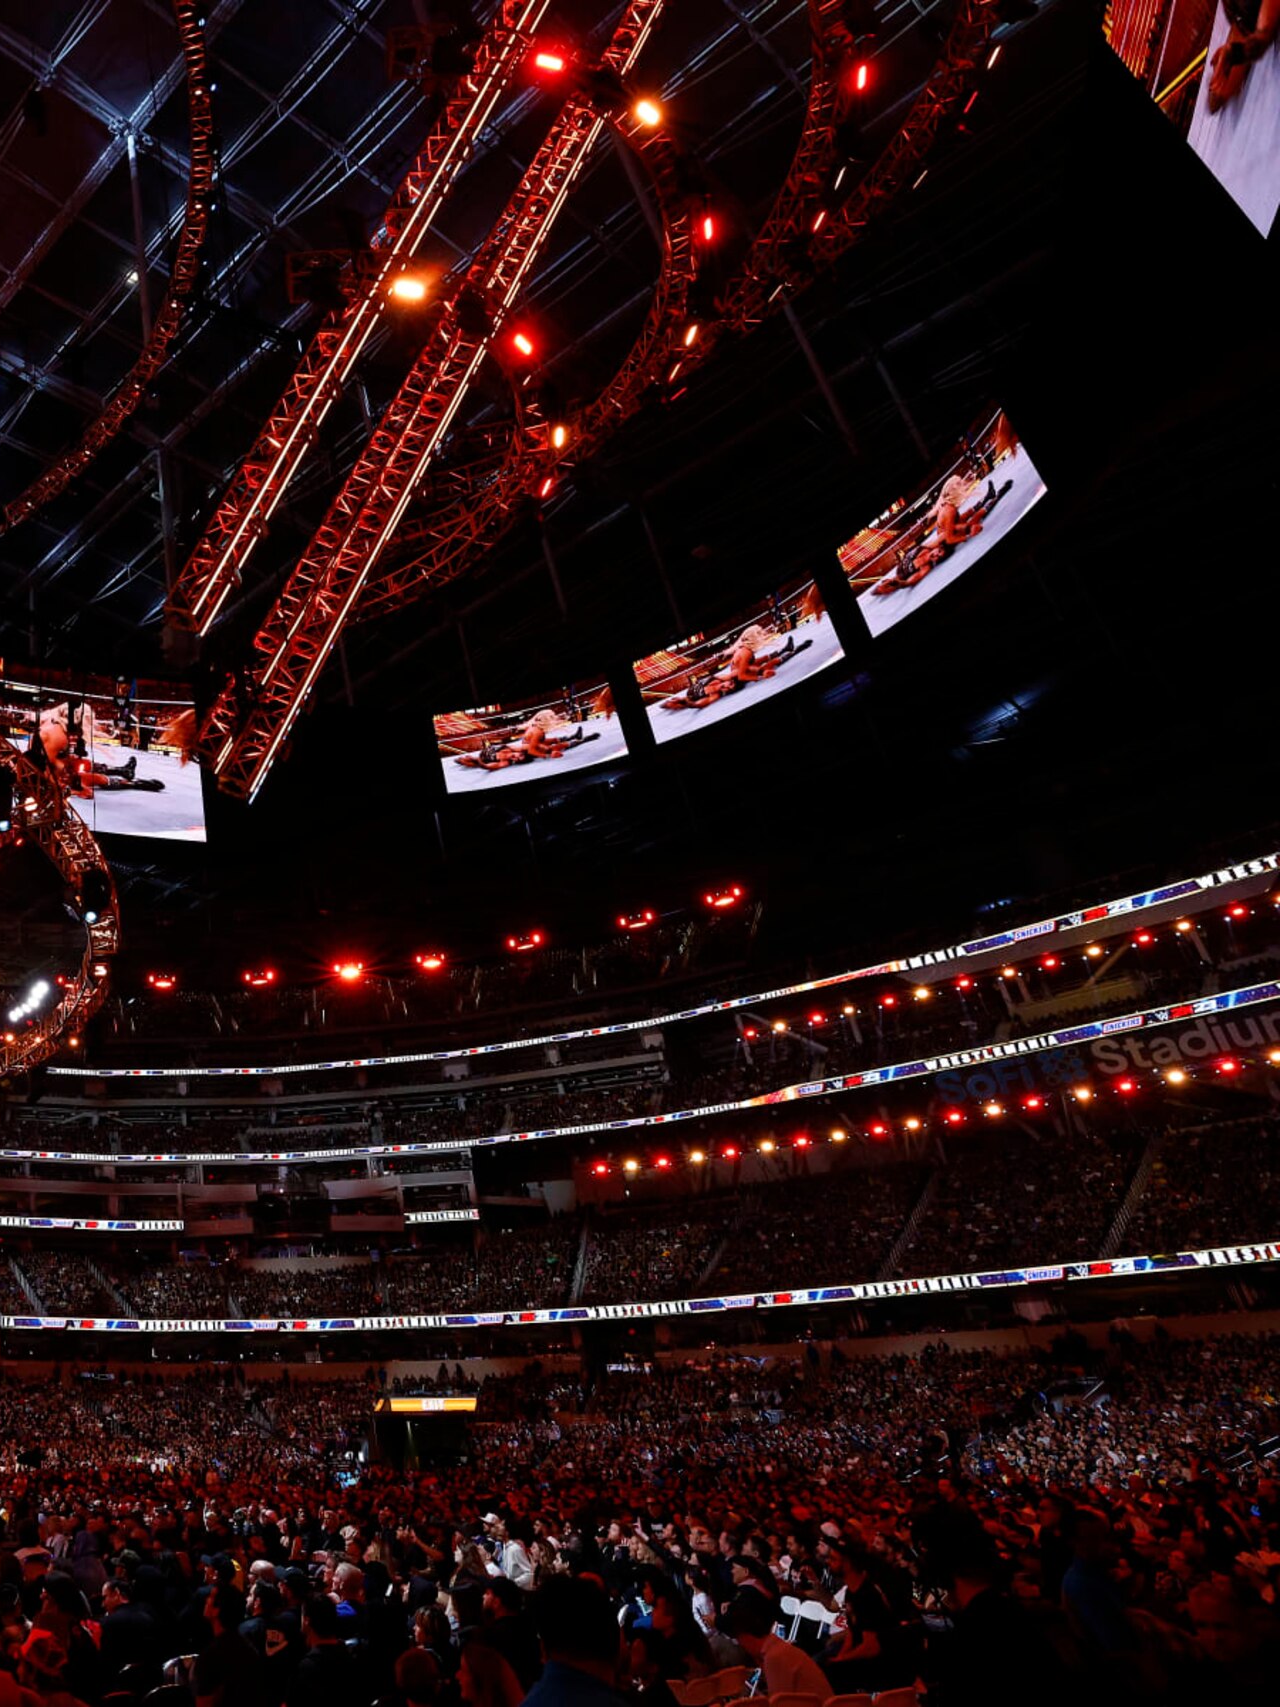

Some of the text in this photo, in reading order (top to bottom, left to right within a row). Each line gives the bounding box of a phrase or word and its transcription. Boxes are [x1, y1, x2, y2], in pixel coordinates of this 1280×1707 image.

[923, 1035, 1058, 1071] WRESTLEMANIA
[933, 1061, 1038, 1102] SoFi
[853, 1274, 981, 1299] WRESTLEMANIA
